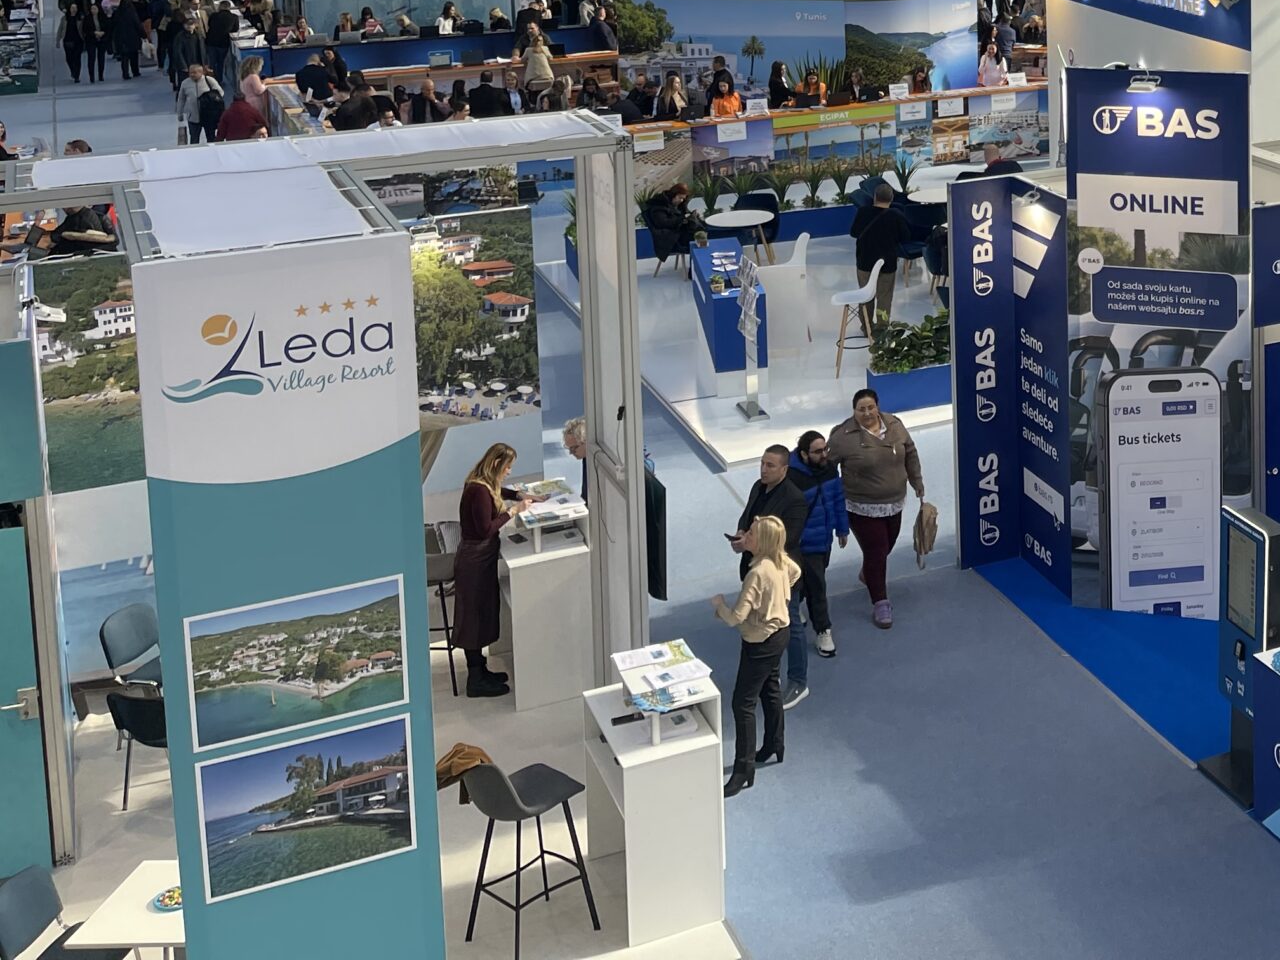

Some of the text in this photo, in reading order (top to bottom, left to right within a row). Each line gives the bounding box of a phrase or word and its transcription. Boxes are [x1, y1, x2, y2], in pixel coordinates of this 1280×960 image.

[803, 12, 827, 21] Tunis
[820, 111, 849, 121] EGIPAT
[1136, 106, 1221, 140] BAS
[1110, 192, 1204, 216] ONLINE
[971, 200, 994, 263] BAS
[1107, 280, 1191, 294] Od sada svoju kartu
[1107, 291, 1136, 301] možeš
[1137, 292, 1149, 301] da
[1180, 295, 1207, 306] online
[1208, 298, 1220, 306] na
[1107, 302, 1205, 316] našem websajtu bas.rs
[259, 316, 394, 368] Leda
[1020, 327, 1043, 354] Samo
[976, 327, 995, 390] BAS
[1020, 351, 1060, 388] jedan klik
[267, 357, 395, 393] Village Resort
[1021, 376, 1059, 413] te deli od
[1021, 401, 1054, 433] sledeće
[1122, 406, 1141, 415] BAS
[1022, 425, 1060, 462] avanture.
[1118, 432, 1182, 446] Bus tickets
[978, 452, 999, 515] BAS
[1033, 540, 1053, 567] BAS
